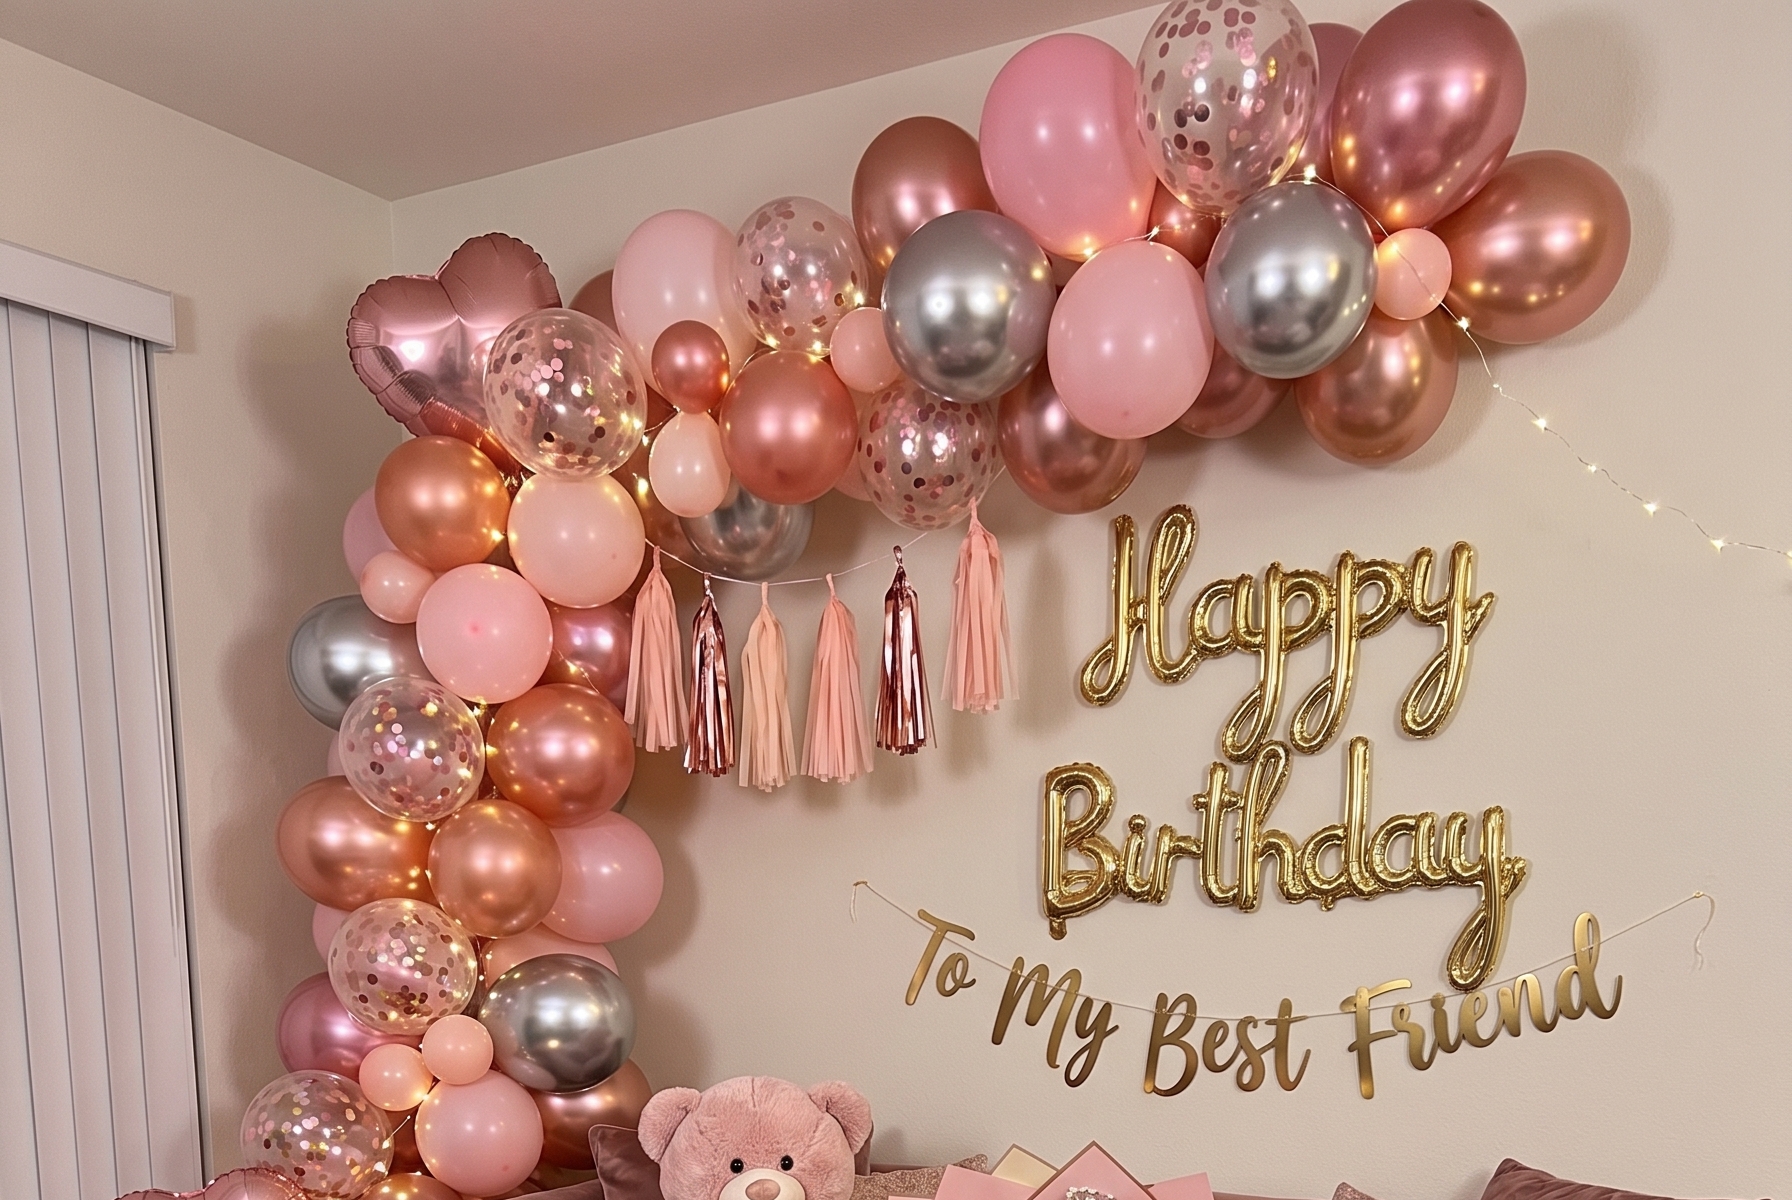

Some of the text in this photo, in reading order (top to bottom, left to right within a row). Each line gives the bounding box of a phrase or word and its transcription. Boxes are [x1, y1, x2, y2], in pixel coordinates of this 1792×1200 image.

[1080, 504, 1494, 762] Happy
[1042, 736, 1526, 991] Birthday
[905, 909, 1622, 1099] To My Best Friend
